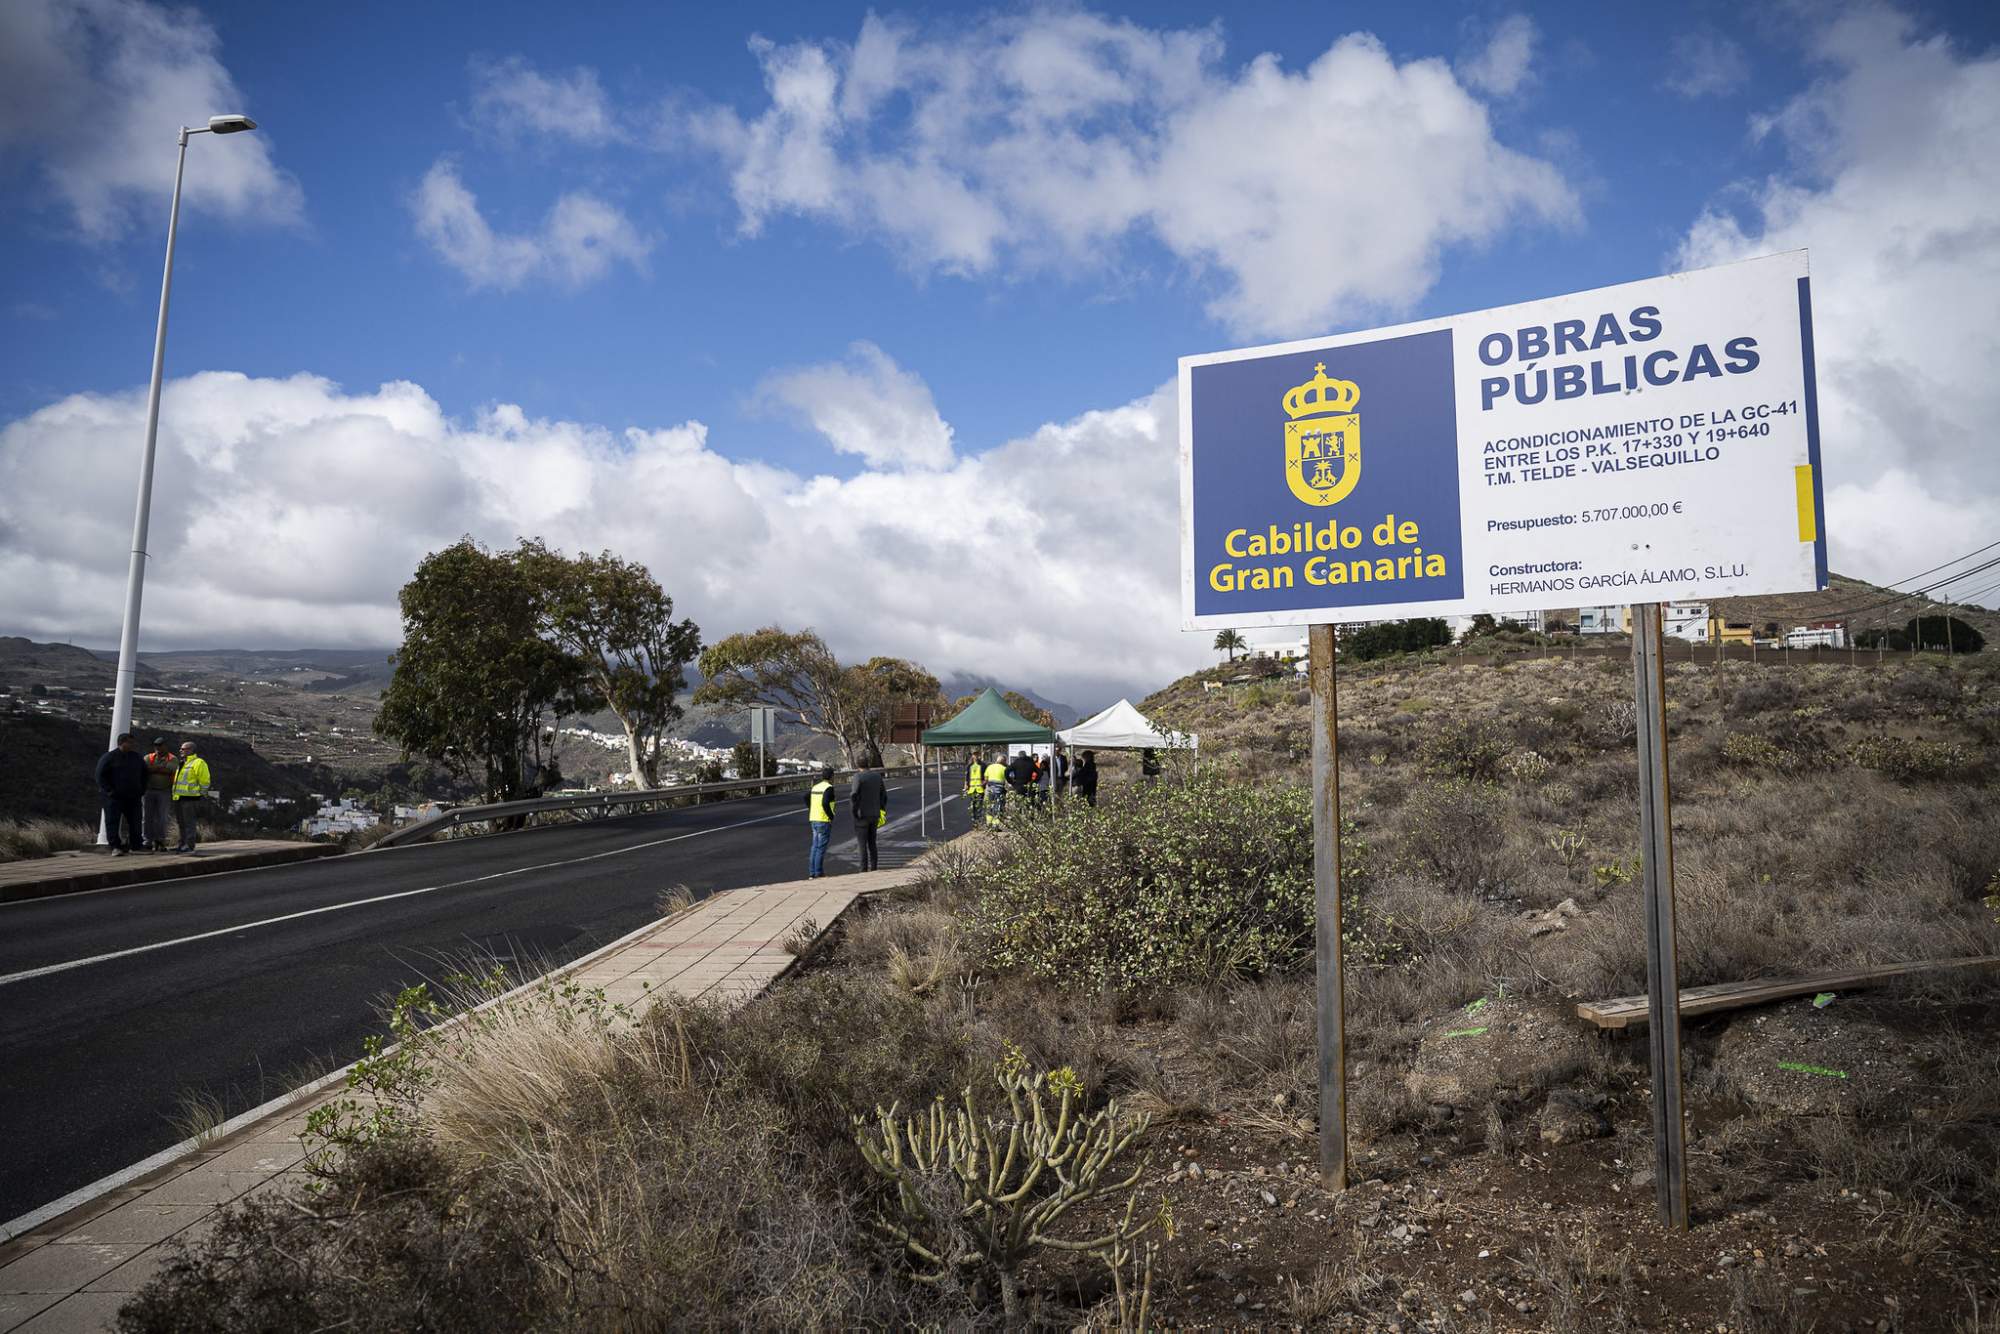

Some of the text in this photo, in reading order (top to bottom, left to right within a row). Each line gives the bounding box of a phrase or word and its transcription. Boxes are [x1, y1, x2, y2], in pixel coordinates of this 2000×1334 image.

[1478, 305, 1663, 366] OBRAS
[1481, 337, 1760, 411] PÚBLICAS
[1483, 400, 1798, 454] ACONDICIONAMIENTO DE LA GC-41
[1484, 422, 1770, 471] ENTRE LOS P.K. 17+330 Y 19+640
[1485, 471, 1516, 486] T.M.
[1520, 464, 1576, 483] TELDE
[1592, 446, 1720, 475] VALSEQUILLO
[1225, 514, 1419, 558] Cabildo de
[1487, 501, 1683, 532] Presupuesto: 5.707.000,00 €
[1209, 548, 1446, 592] Gran Canaria
[1489, 560, 1582, 577] Constructora:
[1490, 564, 1749, 596] HERMANOS GARCÍA ÁLAMO, S.L.U.
